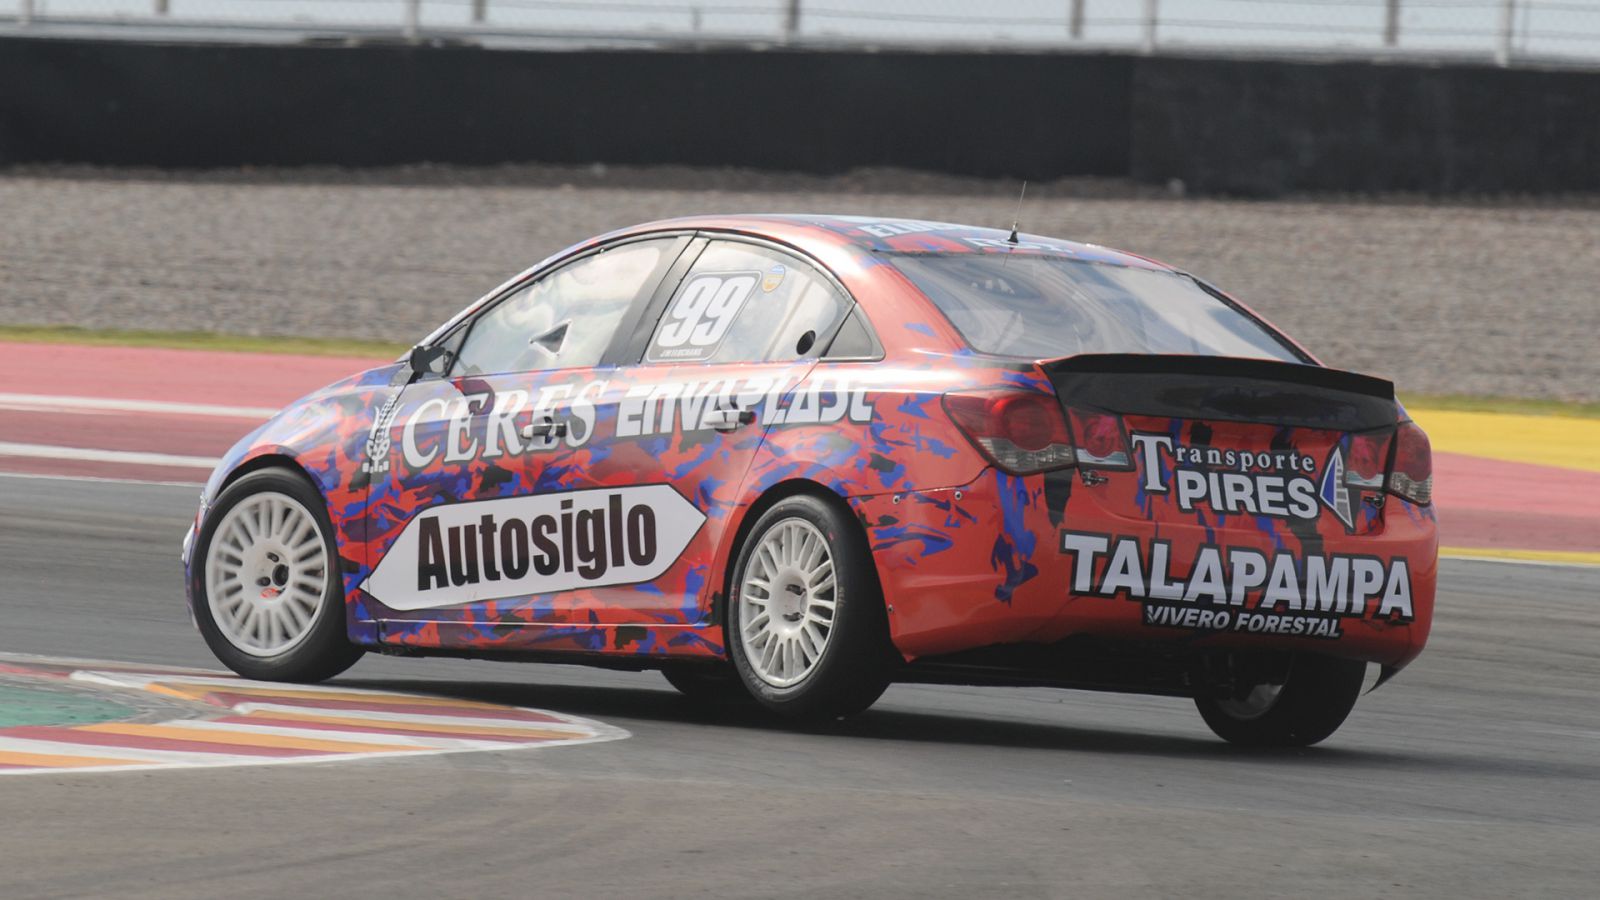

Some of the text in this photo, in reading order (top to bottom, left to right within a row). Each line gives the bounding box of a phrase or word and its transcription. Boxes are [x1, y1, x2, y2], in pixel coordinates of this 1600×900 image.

[657, 276, 756, 347] 99
[402, 379, 610, 468] CERES
[1132, 433, 1315, 491] Transporte
[1176, 470, 1320, 520] PIRES
[417, 494, 657, 592] Autosiglo
[1064, 534, 1414, 618] TALAPAMPA
[1146, 605, 1341, 638] VIVERO FORESTAL
